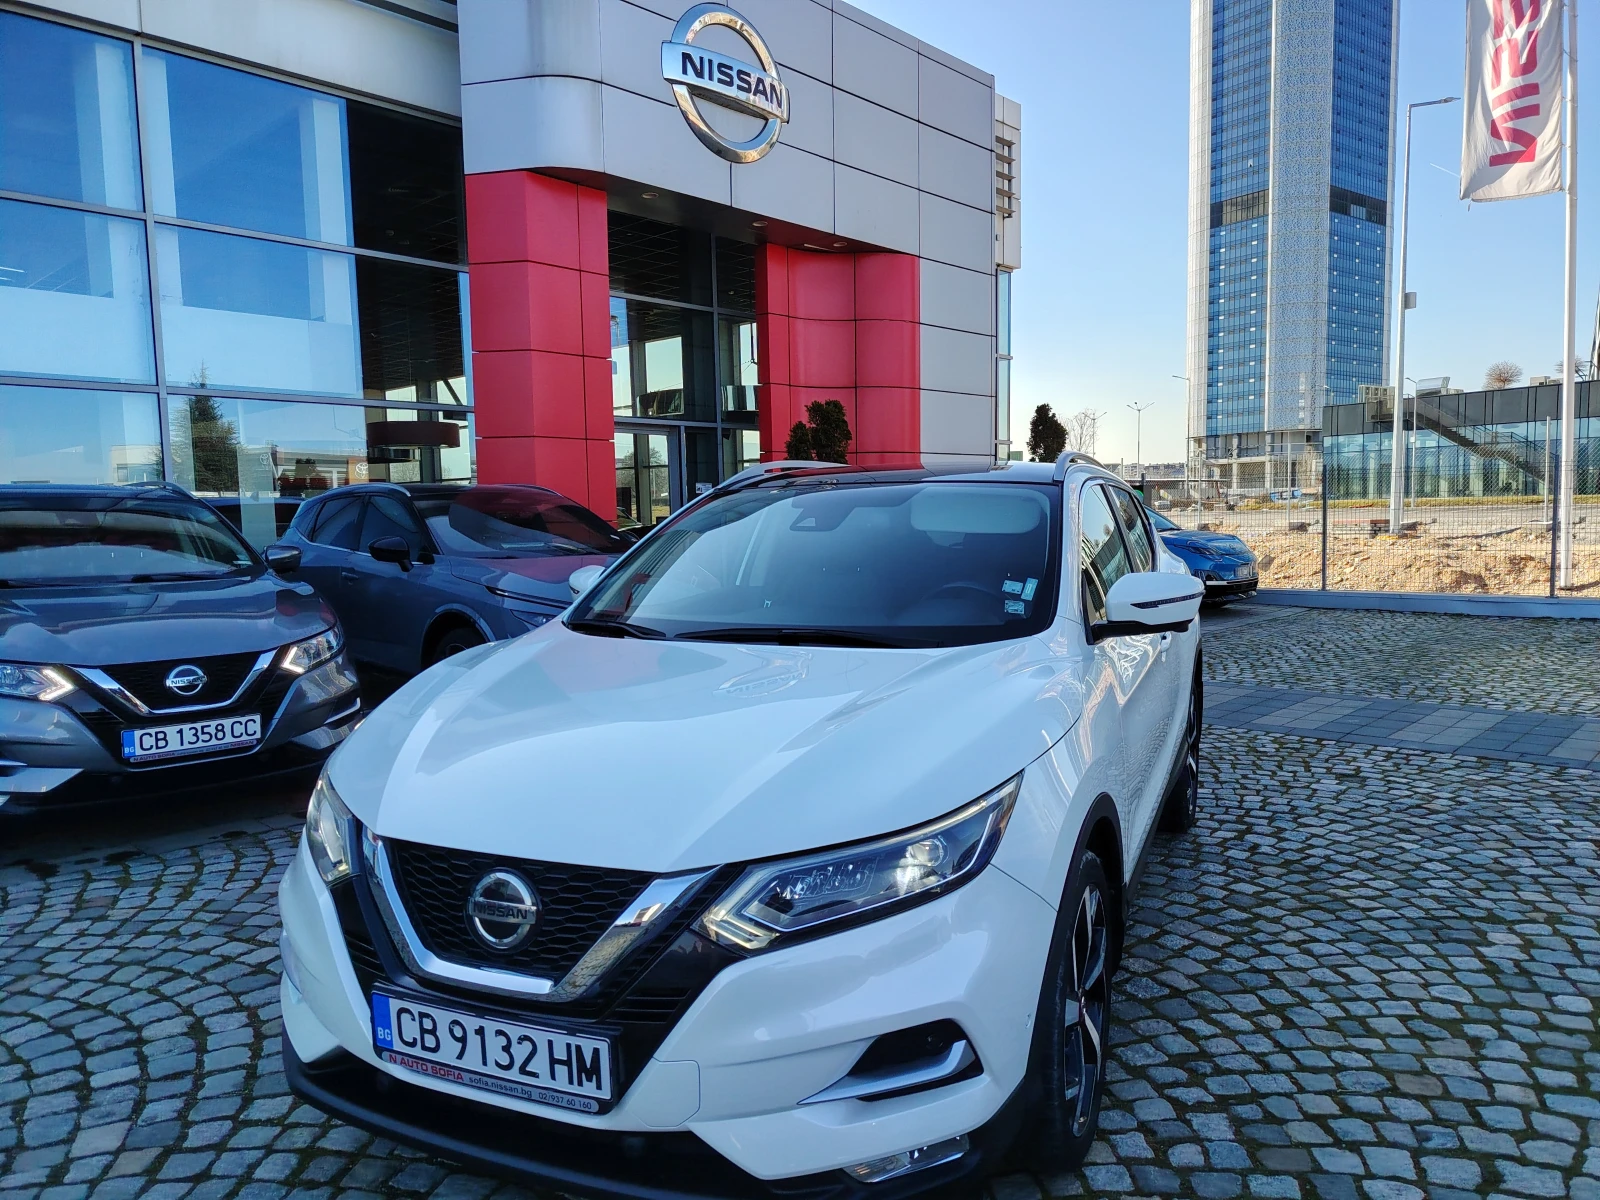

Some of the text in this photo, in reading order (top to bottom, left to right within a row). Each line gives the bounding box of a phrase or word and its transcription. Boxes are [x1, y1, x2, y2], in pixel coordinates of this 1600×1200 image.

[681, 51, 783, 109] NISSAN
[171, 676, 206, 686] NISSAN
[139, 730, 169, 751] CB
[176, 723, 226, 746] 1358
[230, 718, 257, 739] CC
[473, 901, 528, 919] NISSAN
[377, 1026, 392, 1041] BG
[396, 1006, 603, 1091] CB 9132 HM
[388, 1053, 397, 1064] N
[400, 1057, 429, 1072] AUTO
[430, 1065, 464, 1082] SOFIA
[468, 1075, 532, 1098] sofia.nissan.bg
